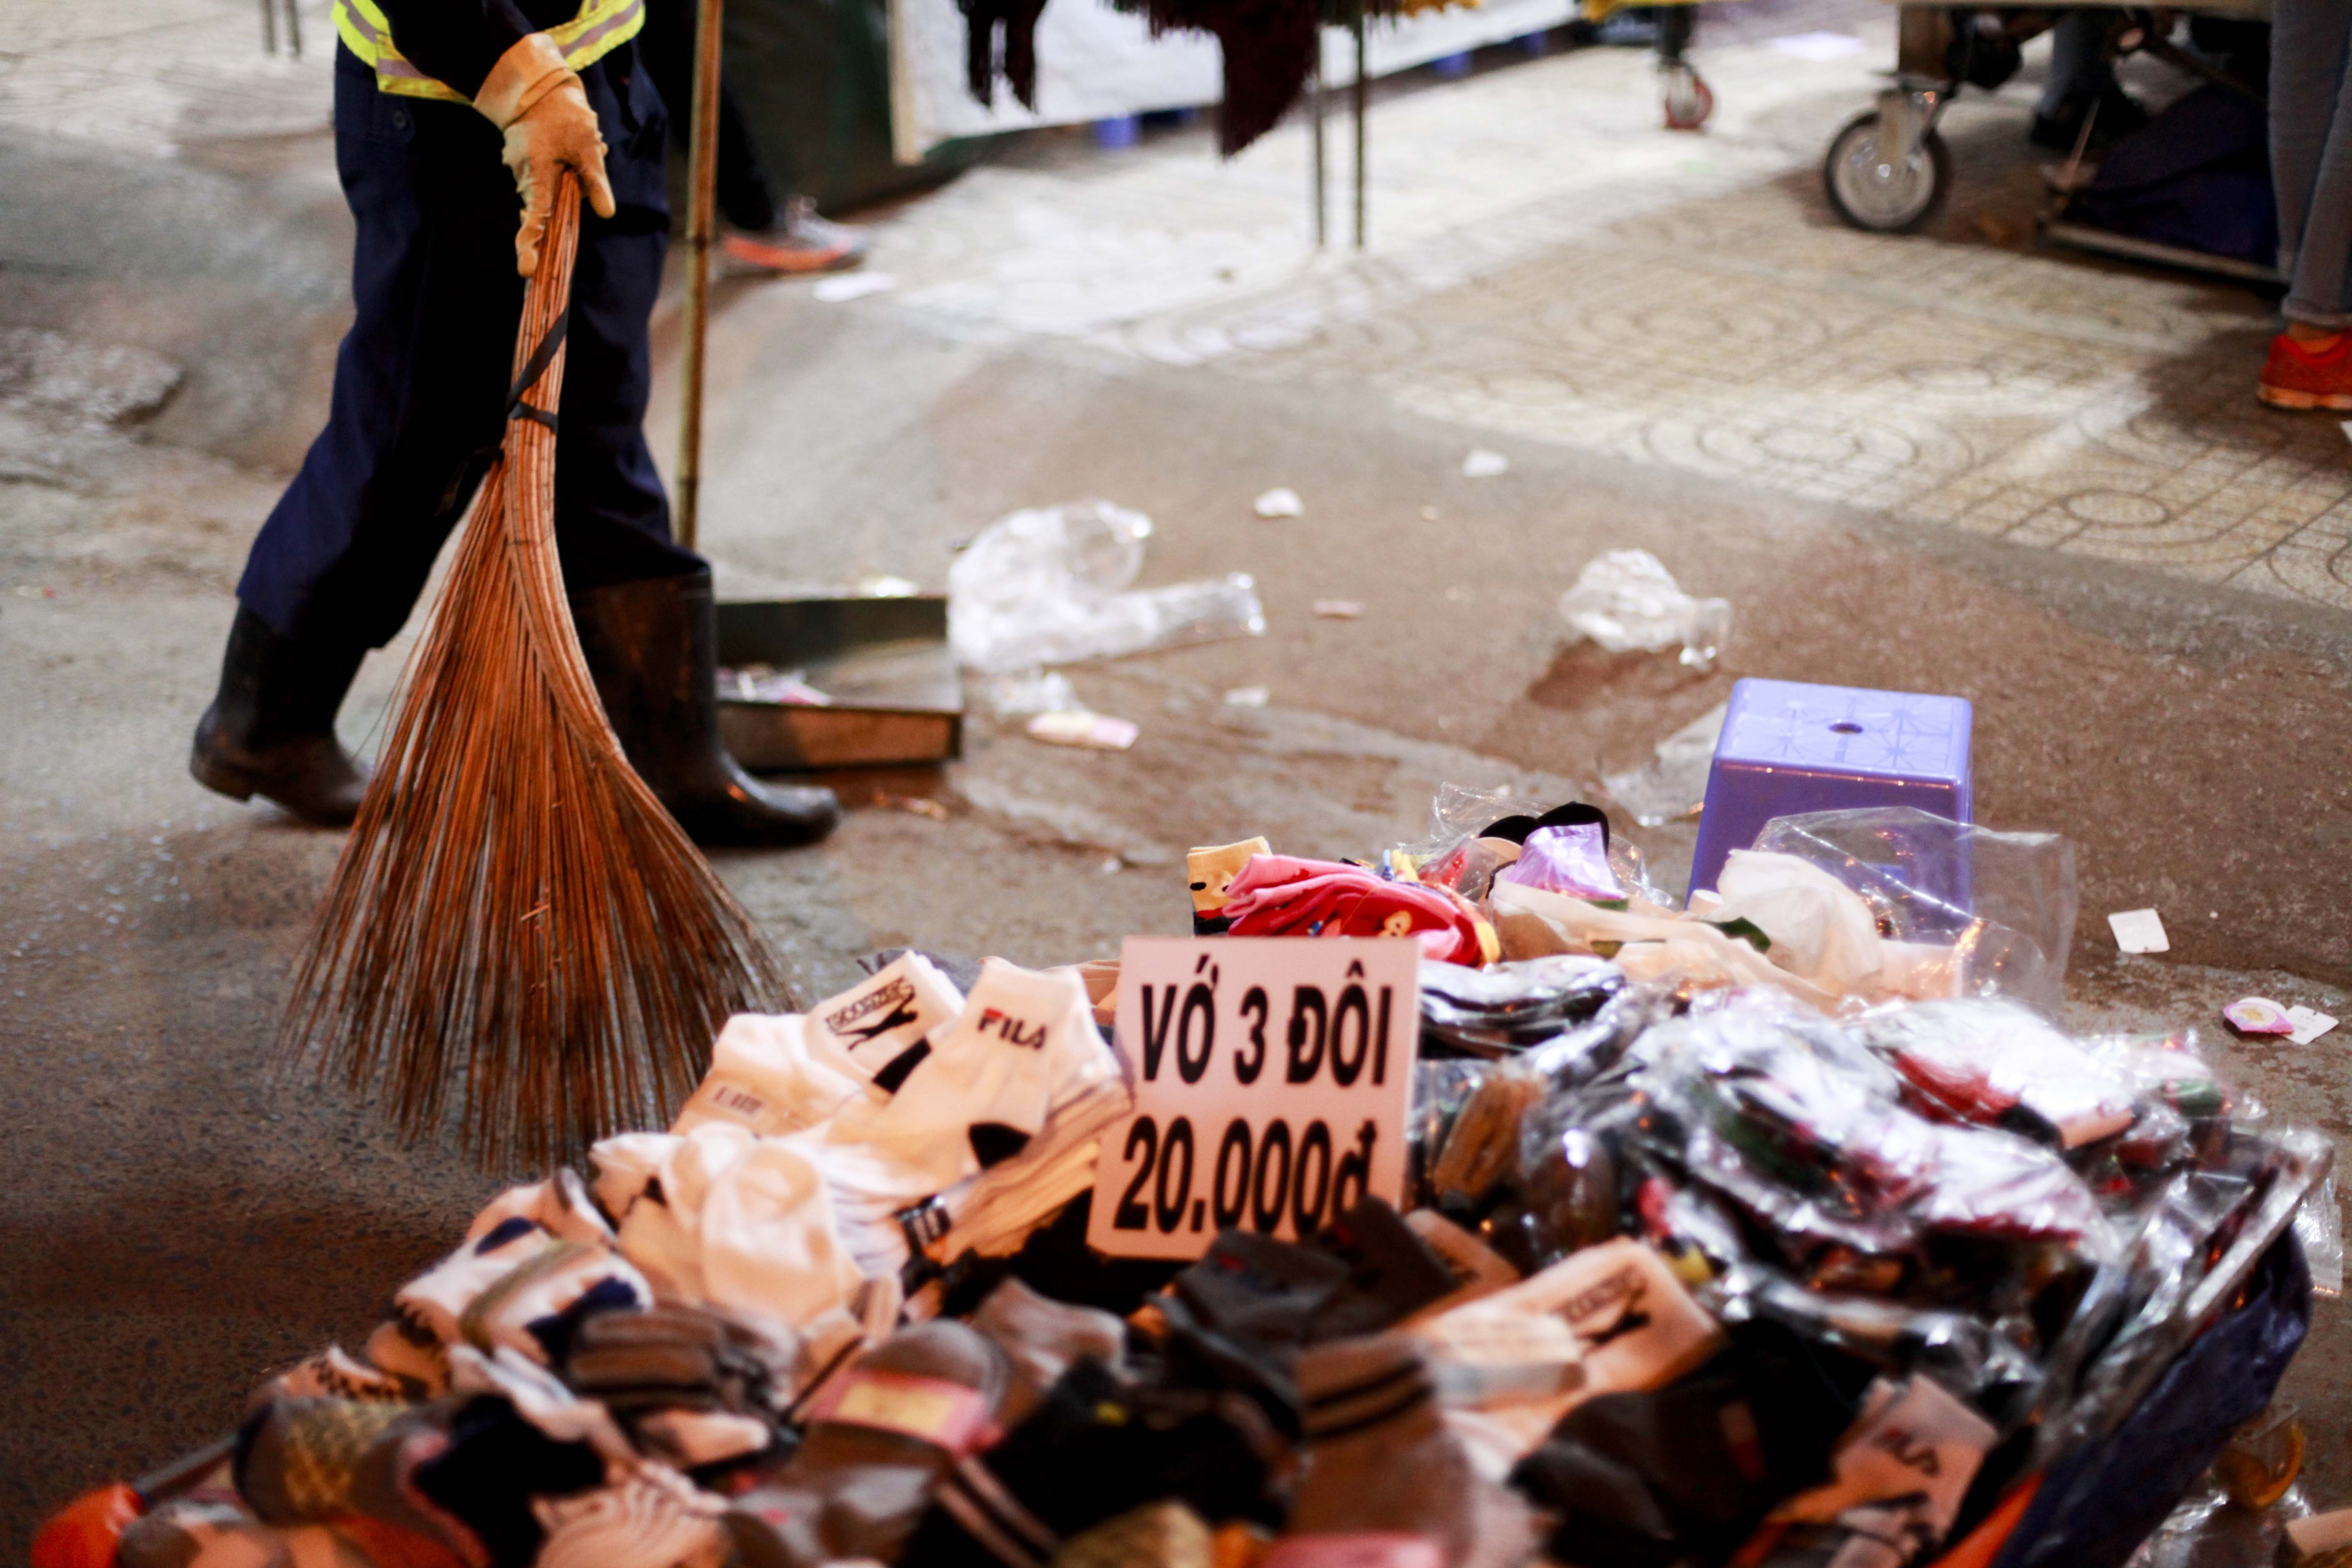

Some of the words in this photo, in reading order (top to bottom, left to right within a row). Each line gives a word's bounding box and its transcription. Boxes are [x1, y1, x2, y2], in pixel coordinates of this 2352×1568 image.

[977, 1008, 1047, 1050] FILA
[1140, 953, 1219, 1085] VỚ
[1233, 985, 1269, 1085] 3
[1286, 959, 1393, 1087] ĐÔI
